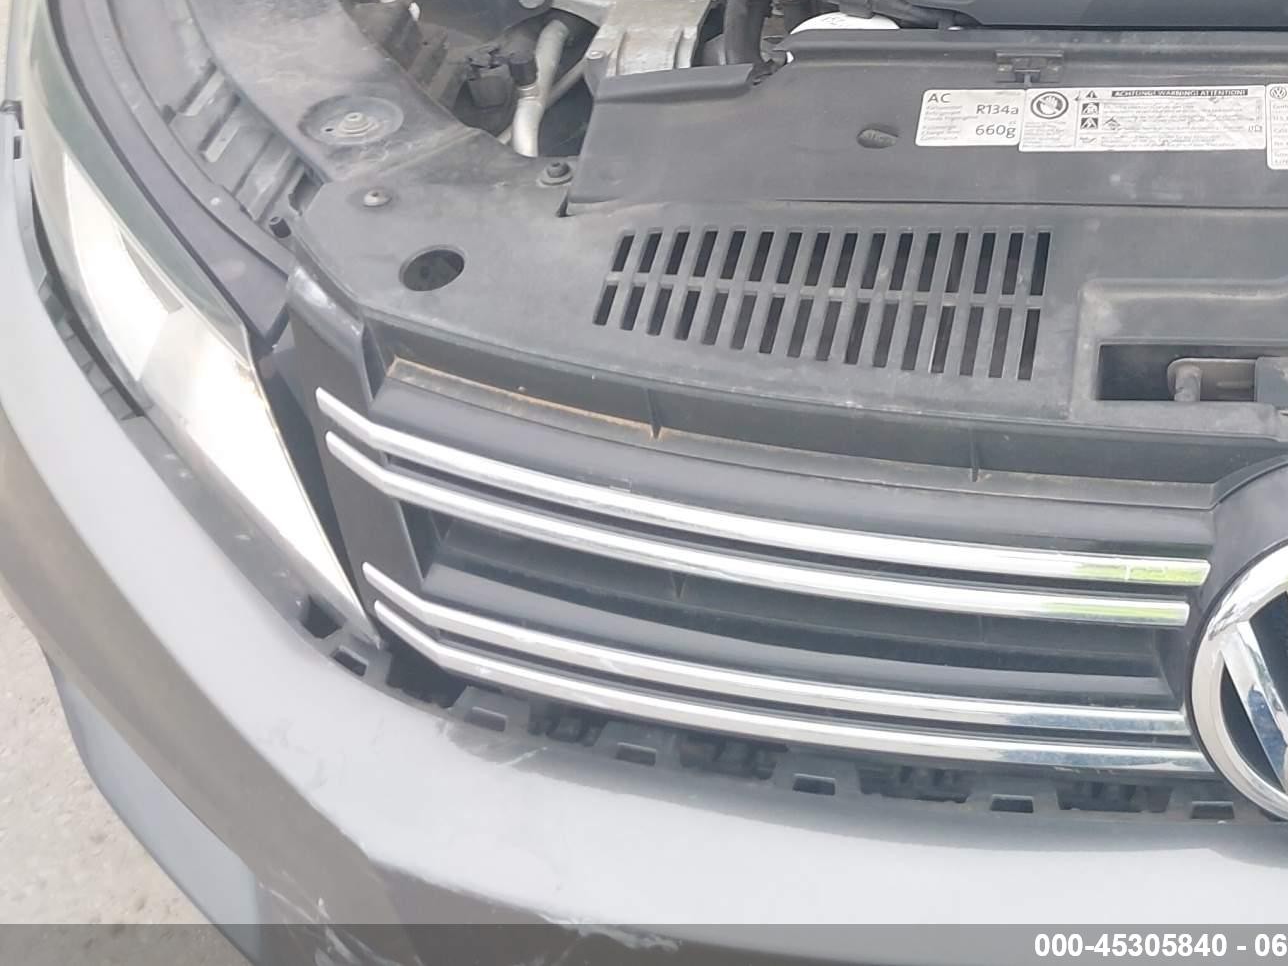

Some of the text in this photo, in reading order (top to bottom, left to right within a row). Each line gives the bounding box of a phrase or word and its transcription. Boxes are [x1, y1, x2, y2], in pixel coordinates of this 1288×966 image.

[927, 92, 952, 103] AC
[1158, 89, 1199, 97] WARNING!
[976, 104, 1019, 115] R134a
[975, 124, 1017, 139] 660g
